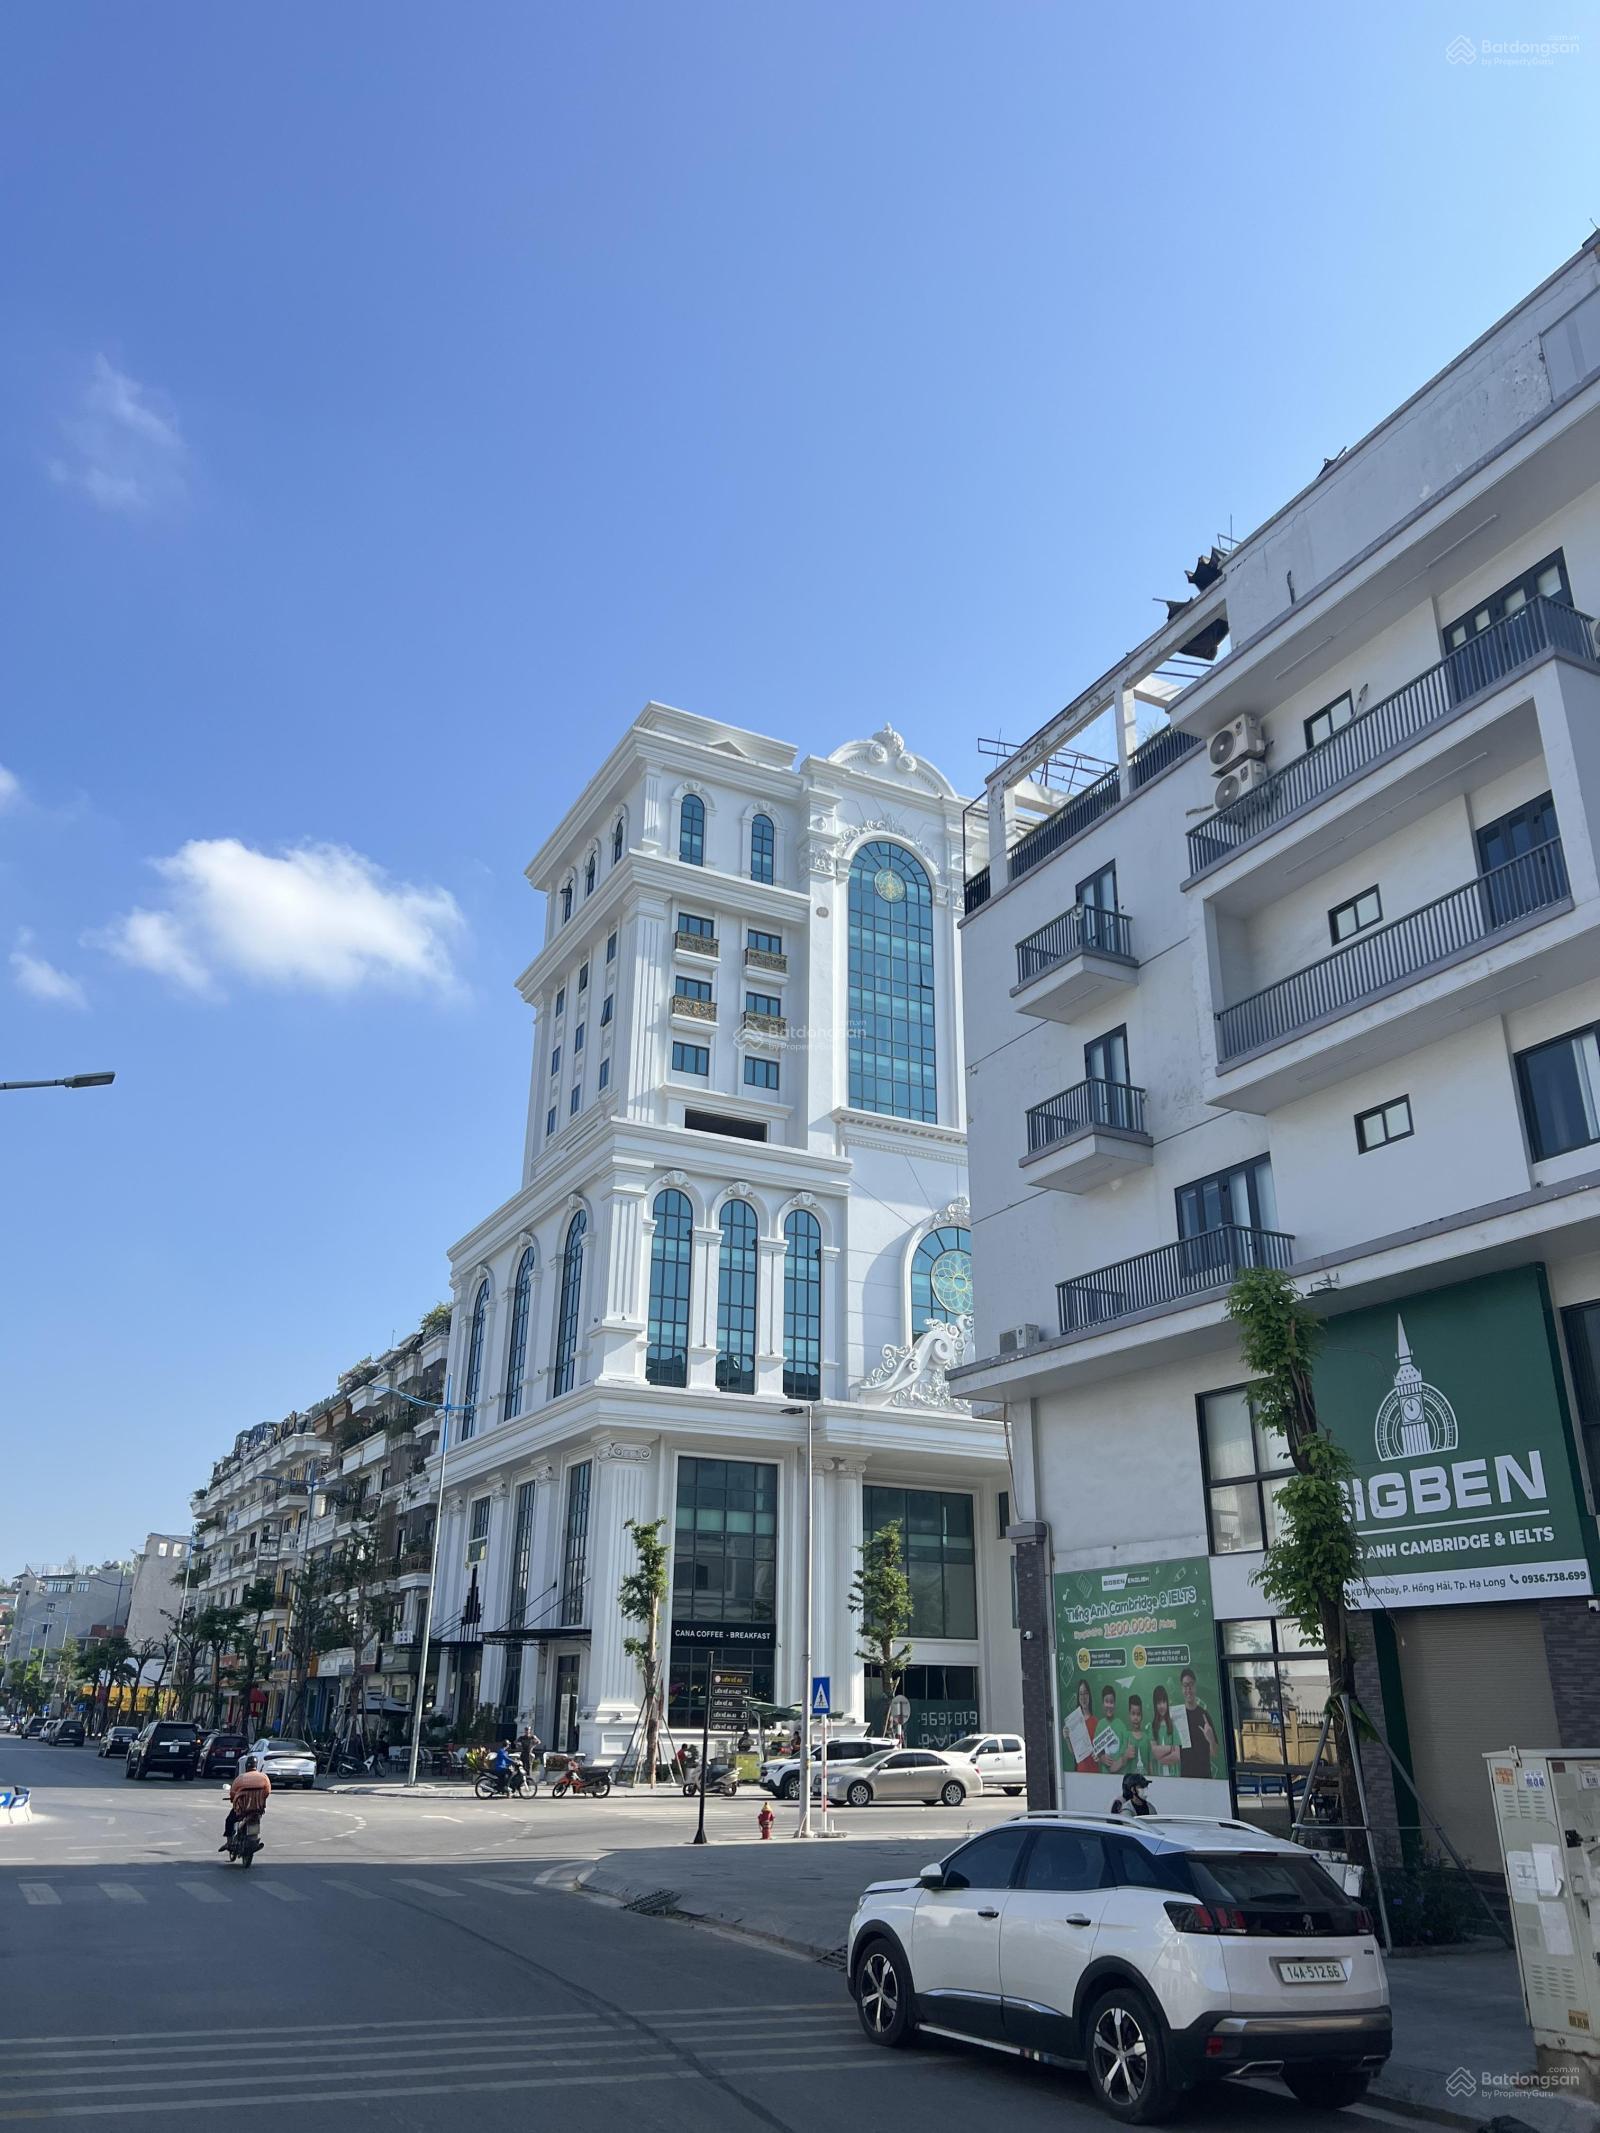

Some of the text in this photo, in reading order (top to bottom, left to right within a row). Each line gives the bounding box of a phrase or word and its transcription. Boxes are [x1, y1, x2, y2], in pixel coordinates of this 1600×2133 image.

[1367, 1543, 1397, 1559] ANH
[1400, 1533, 1491, 1556] CAMBRIDGE
[1494, 1531, 1506, 1547] &
[1509, 1526, 1555, 1545] IELTS
[1521, 1570, 1587, 1584] 0936.738.699
[1403, 1584, 1411, 1593] P.
[1412, 1581, 1435, 1594] Hồng
[1436, 1580, 1453, 1591] Hải,
[1454, 1580, 1468, 1591] Tp.
[1469, 1579, 1482, 1590] Hạ
[1483, 1578, 1506, 1588] Long
[1091, 1603, 1109, 1617] Anh
[1109, 1595, 1159, 1614] Cambridge
[1159, 1591, 1167, 1607] &
[1168, 1586, 1196, 1605] IELTS
[675, 1629, 695, 1637] CANA
[696, 1630, 724, 1638] COFFEE
[730, 1631, 770, 1639] BREAKFAST
[1287, 1965, 1340, 1979] 14A-512.66
